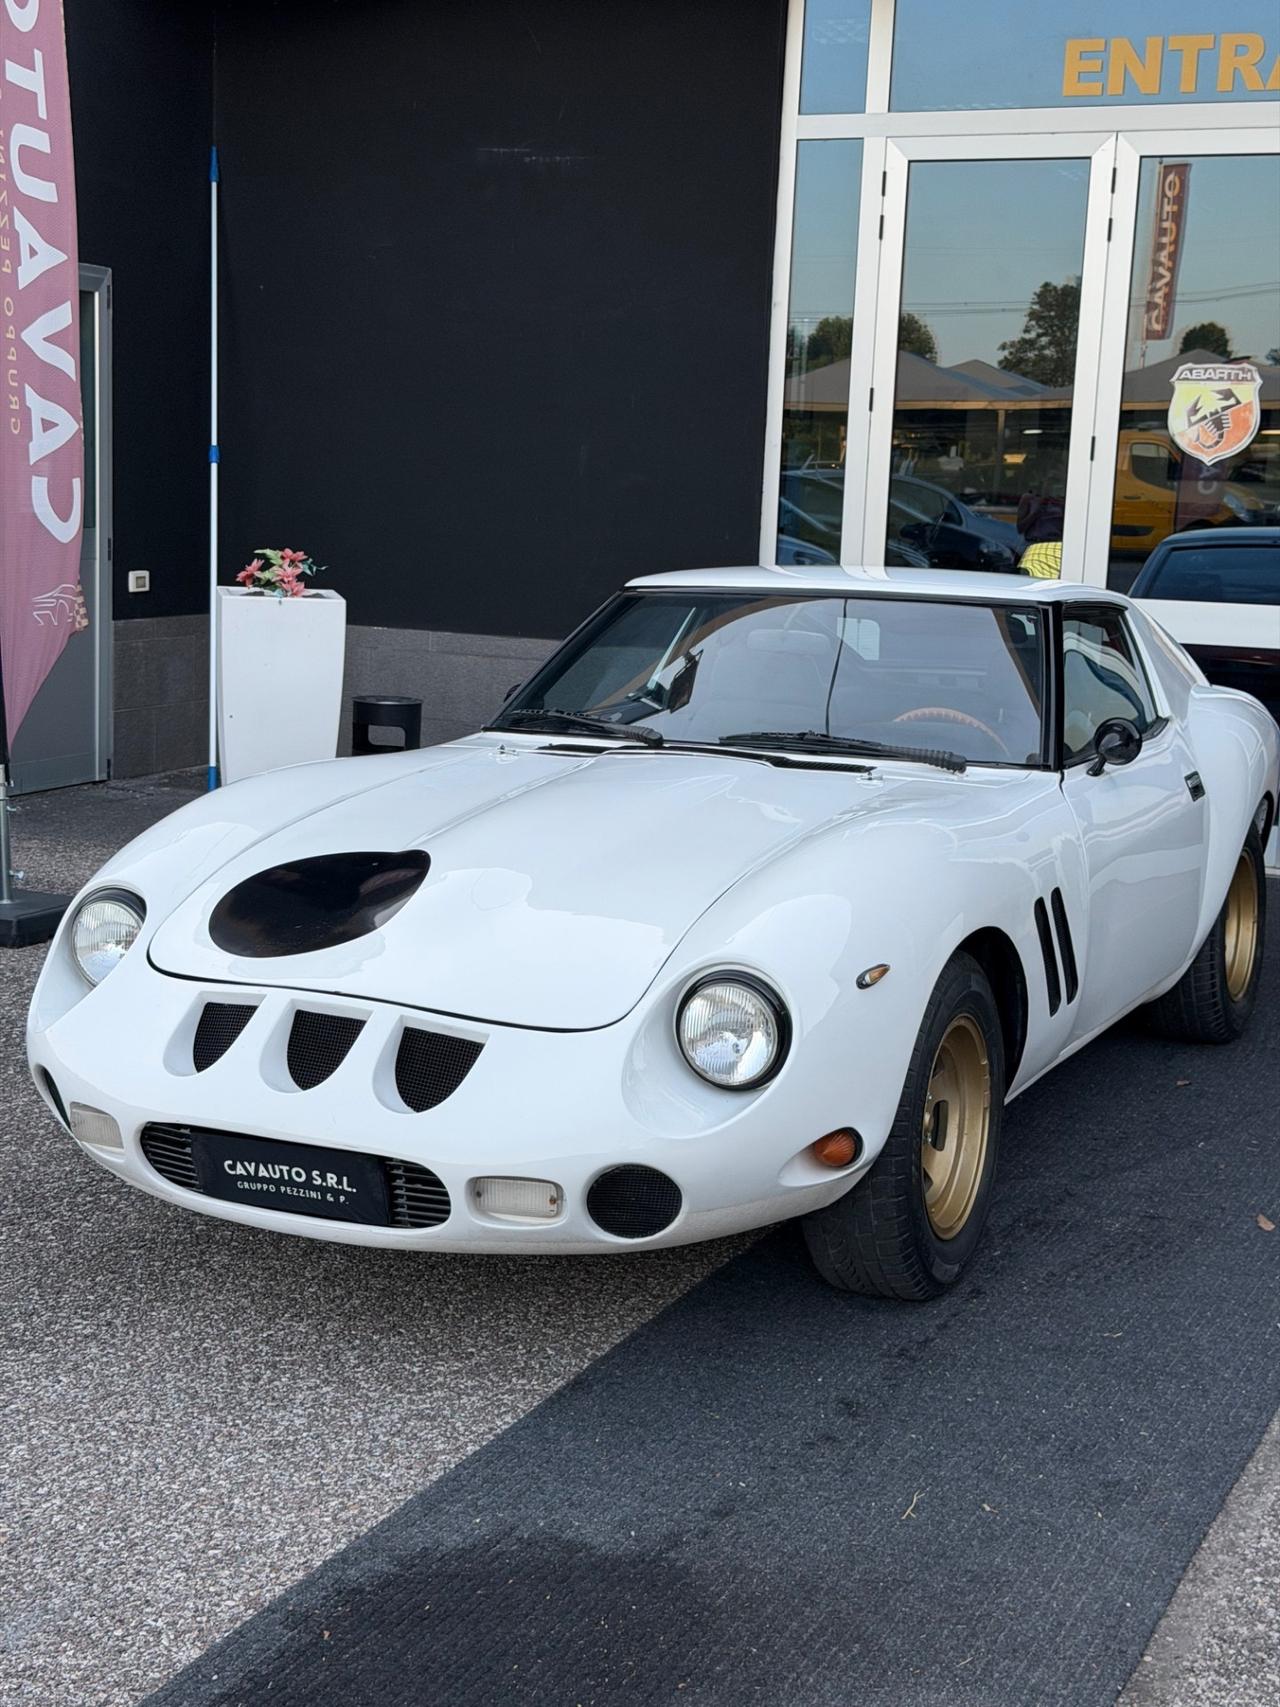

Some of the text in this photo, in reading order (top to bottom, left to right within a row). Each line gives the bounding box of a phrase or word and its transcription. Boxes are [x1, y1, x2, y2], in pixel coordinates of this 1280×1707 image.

[1062, 33, 1280, 97] ENTR
[1151, 171, 1181, 332] CAVAUTO
[1179, 368, 1251, 380] ABARTH
[223, 1160, 357, 1193] CAVAUTO S.R.L.
[237, 1180, 276, 1192] GRUPPO
[280, 1185, 322, 1200] PEZZINI
[326, 1193, 334, 1202] &
